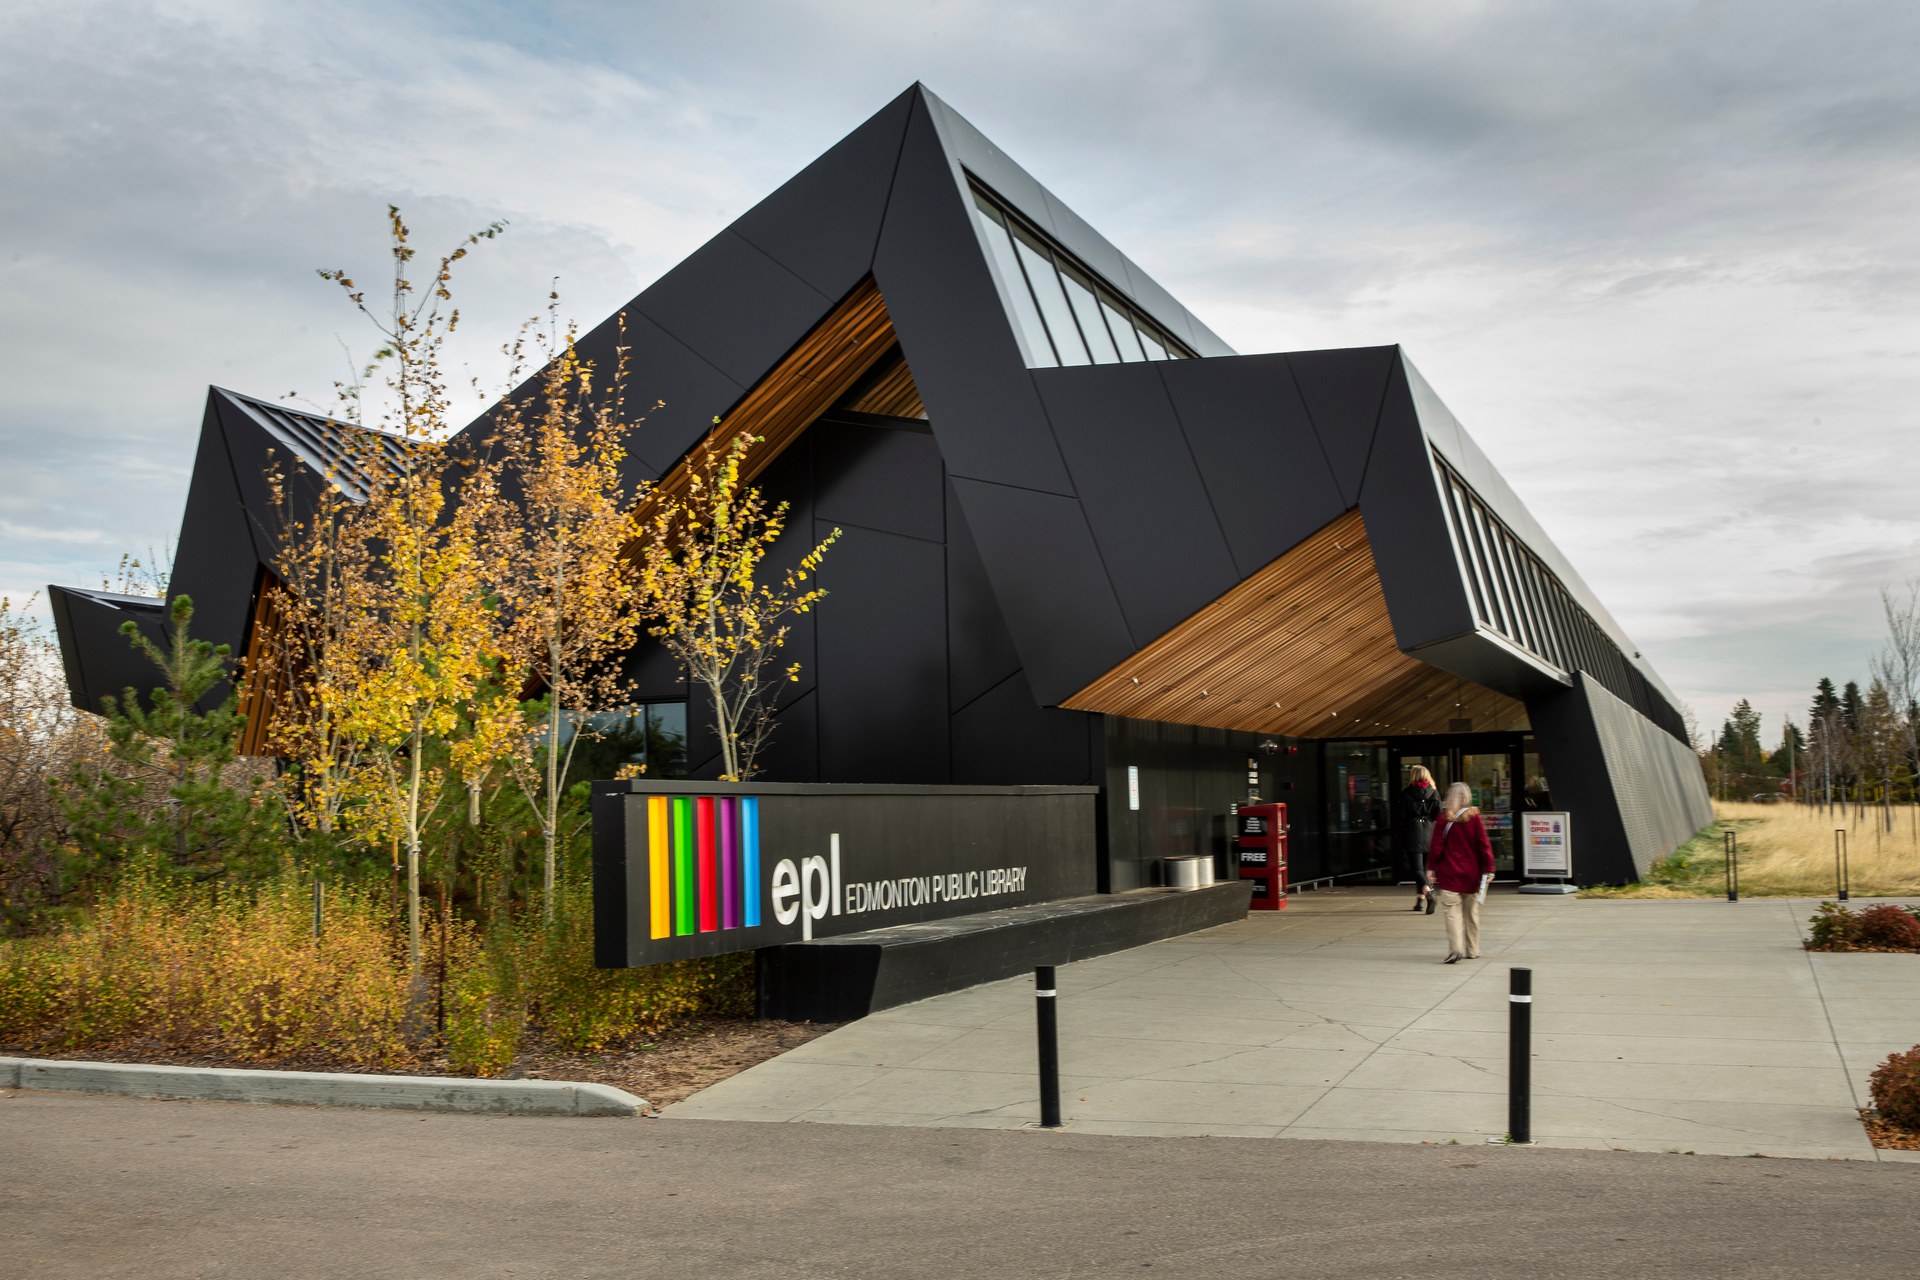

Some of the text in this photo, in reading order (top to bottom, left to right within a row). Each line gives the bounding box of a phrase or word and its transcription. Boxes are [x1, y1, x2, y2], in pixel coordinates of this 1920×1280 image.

[1240, 852, 1267, 862] FREE
[771, 833, 841, 941] epl
[845, 866, 1027, 915] EDMONTON PUBLIC LIBRARY
